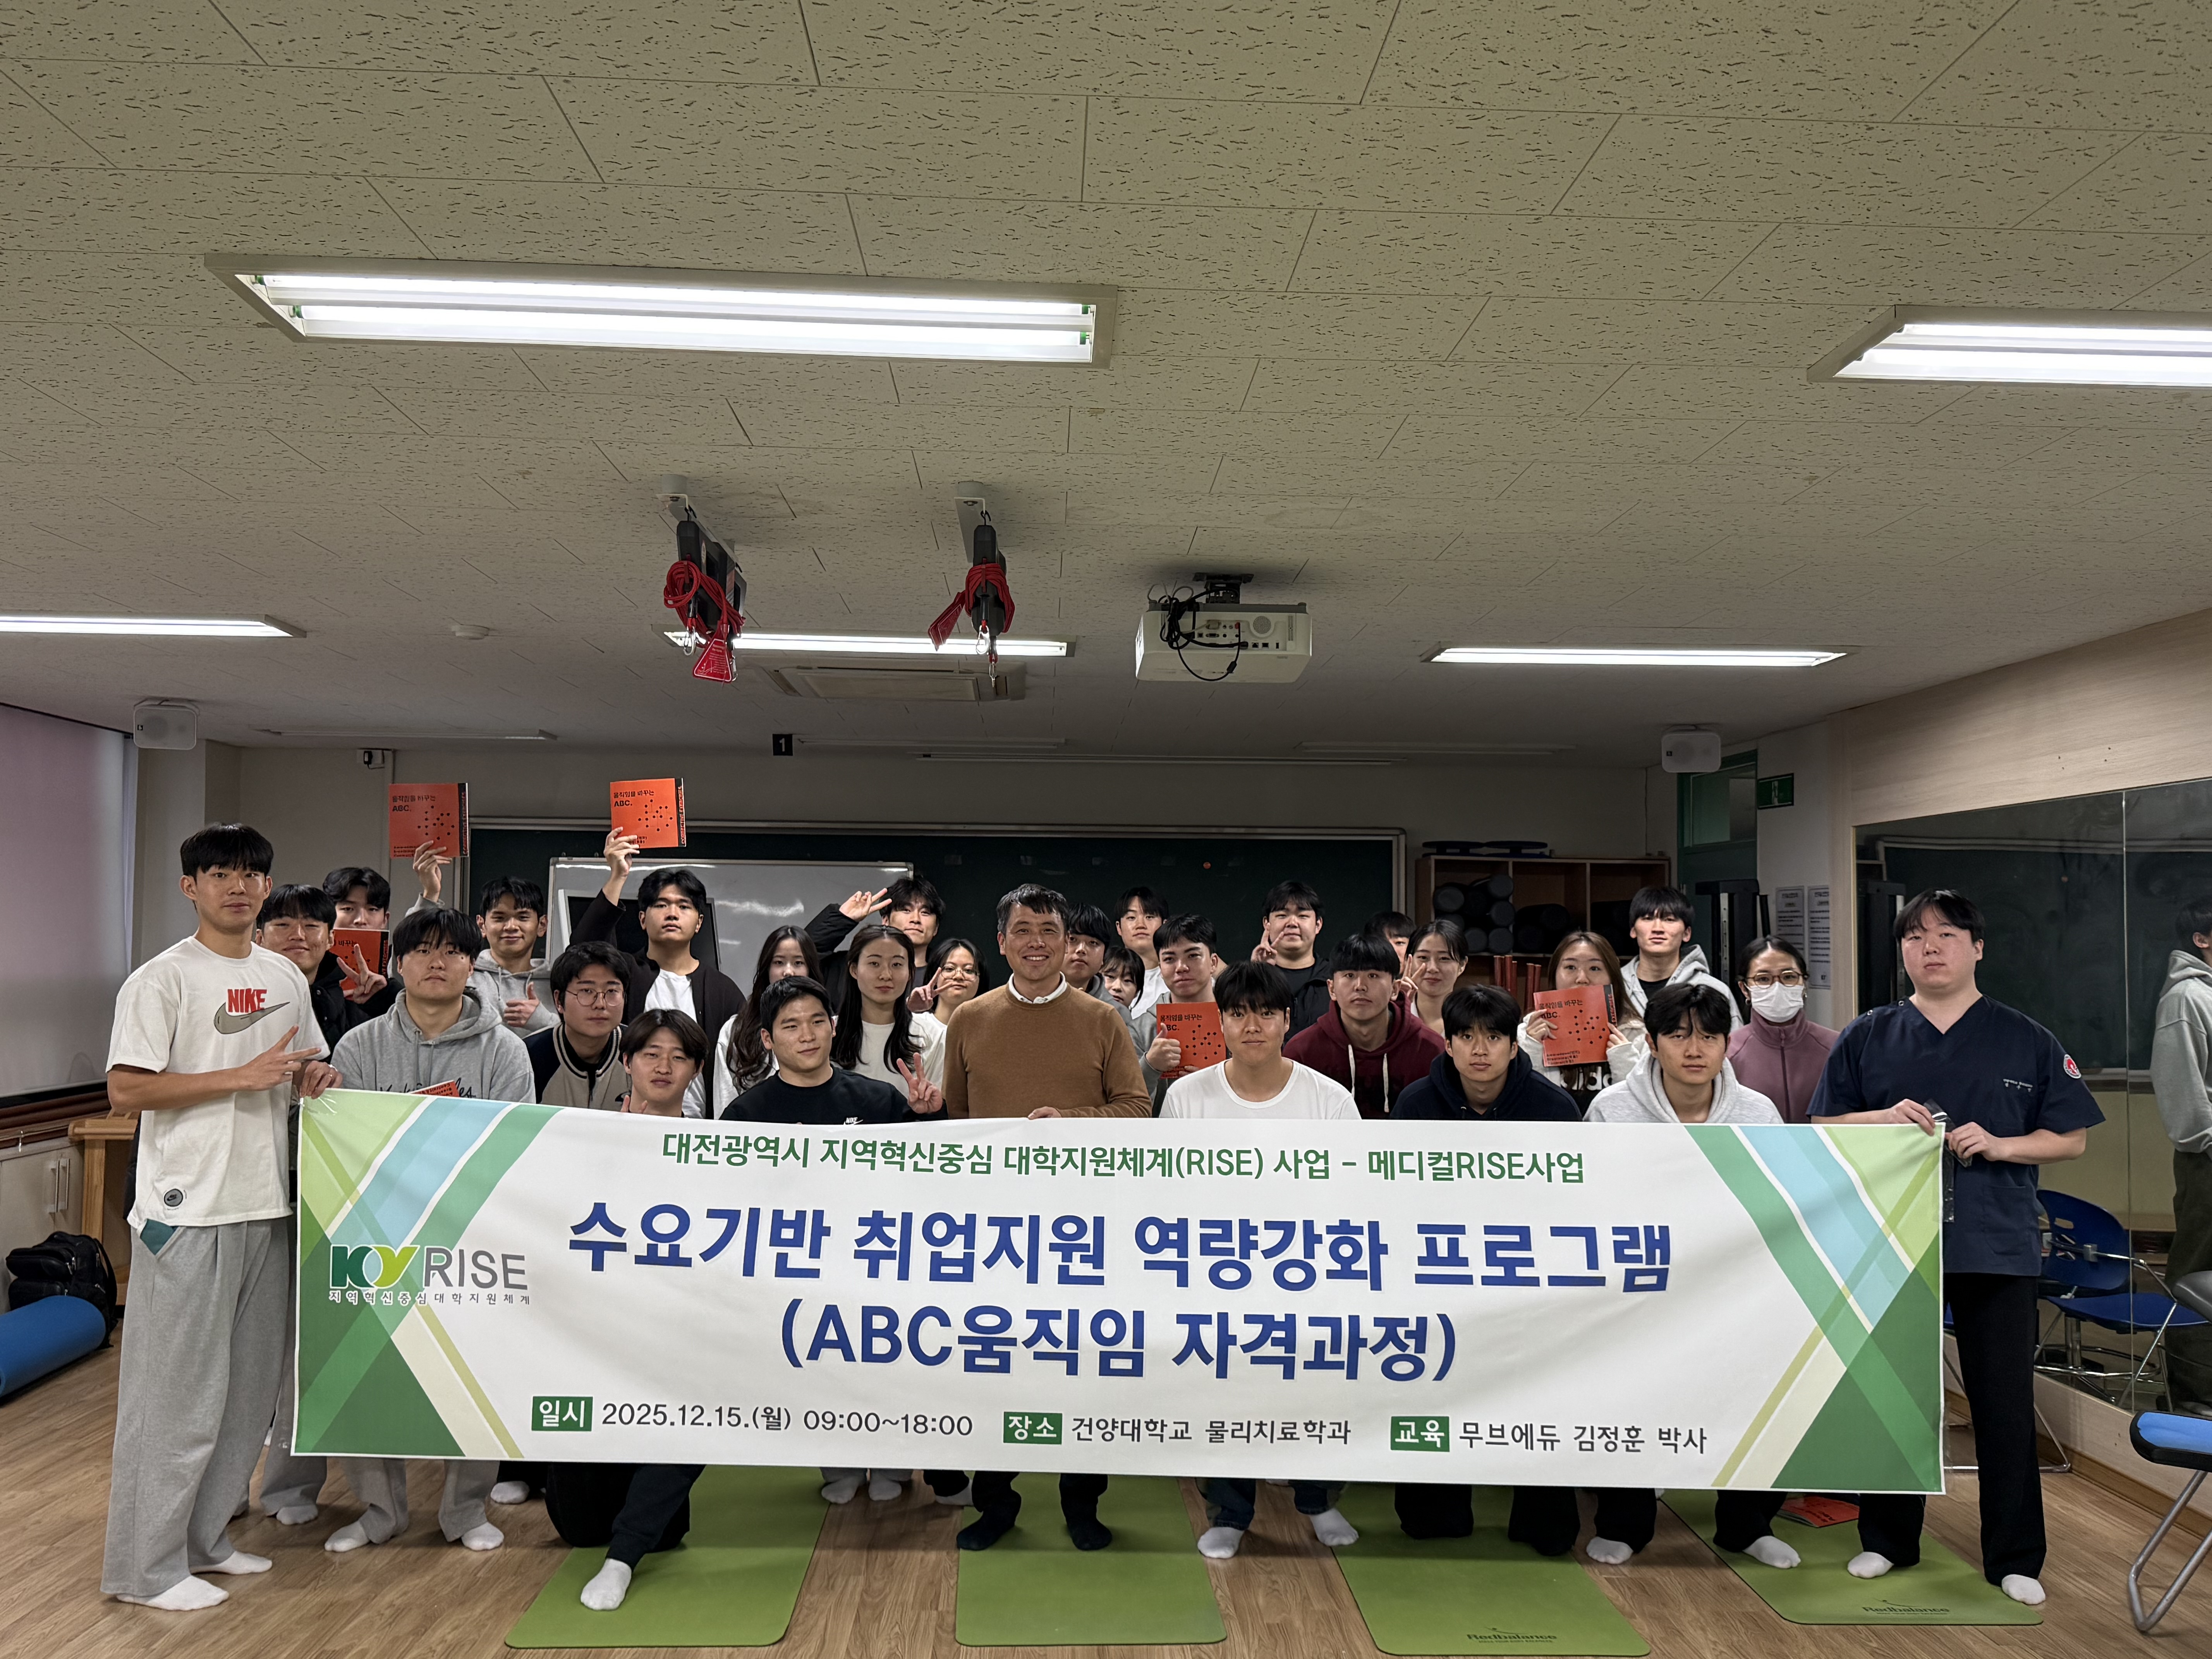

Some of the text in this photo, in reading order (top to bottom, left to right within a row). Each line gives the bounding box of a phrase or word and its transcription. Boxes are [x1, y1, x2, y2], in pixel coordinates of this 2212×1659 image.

[779, 738, 785, 752] 1
[228, 988, 267, 1013] NIKE
[663, 1134, 809, 1168] 대전광역시
[820, 1139, 992, 1175] 지역혁신중심
[1004, 1146, 1263, 1179] 대학지원체계(RISE)
[1273, 1149, 1329, 1179] 사업
[1368, 1151, 1583, 1183] 메디컬RISE사업
[569, 1202, 1671, 1293] 수요기반 취업지원 역량강화 프로그램
[781, 1298, 1456, 1382] (ABC움직임 자격과정)
[539, 1400, 973, 1436] 일시 2025.12.15.(월) 09:00~18:00
[1008, 1416, 1352, 1444] 장소 건양대학교 물리치료학과
[1395, 1420, 1707, 1454] 교육 무브에듀 김정훈 박사
